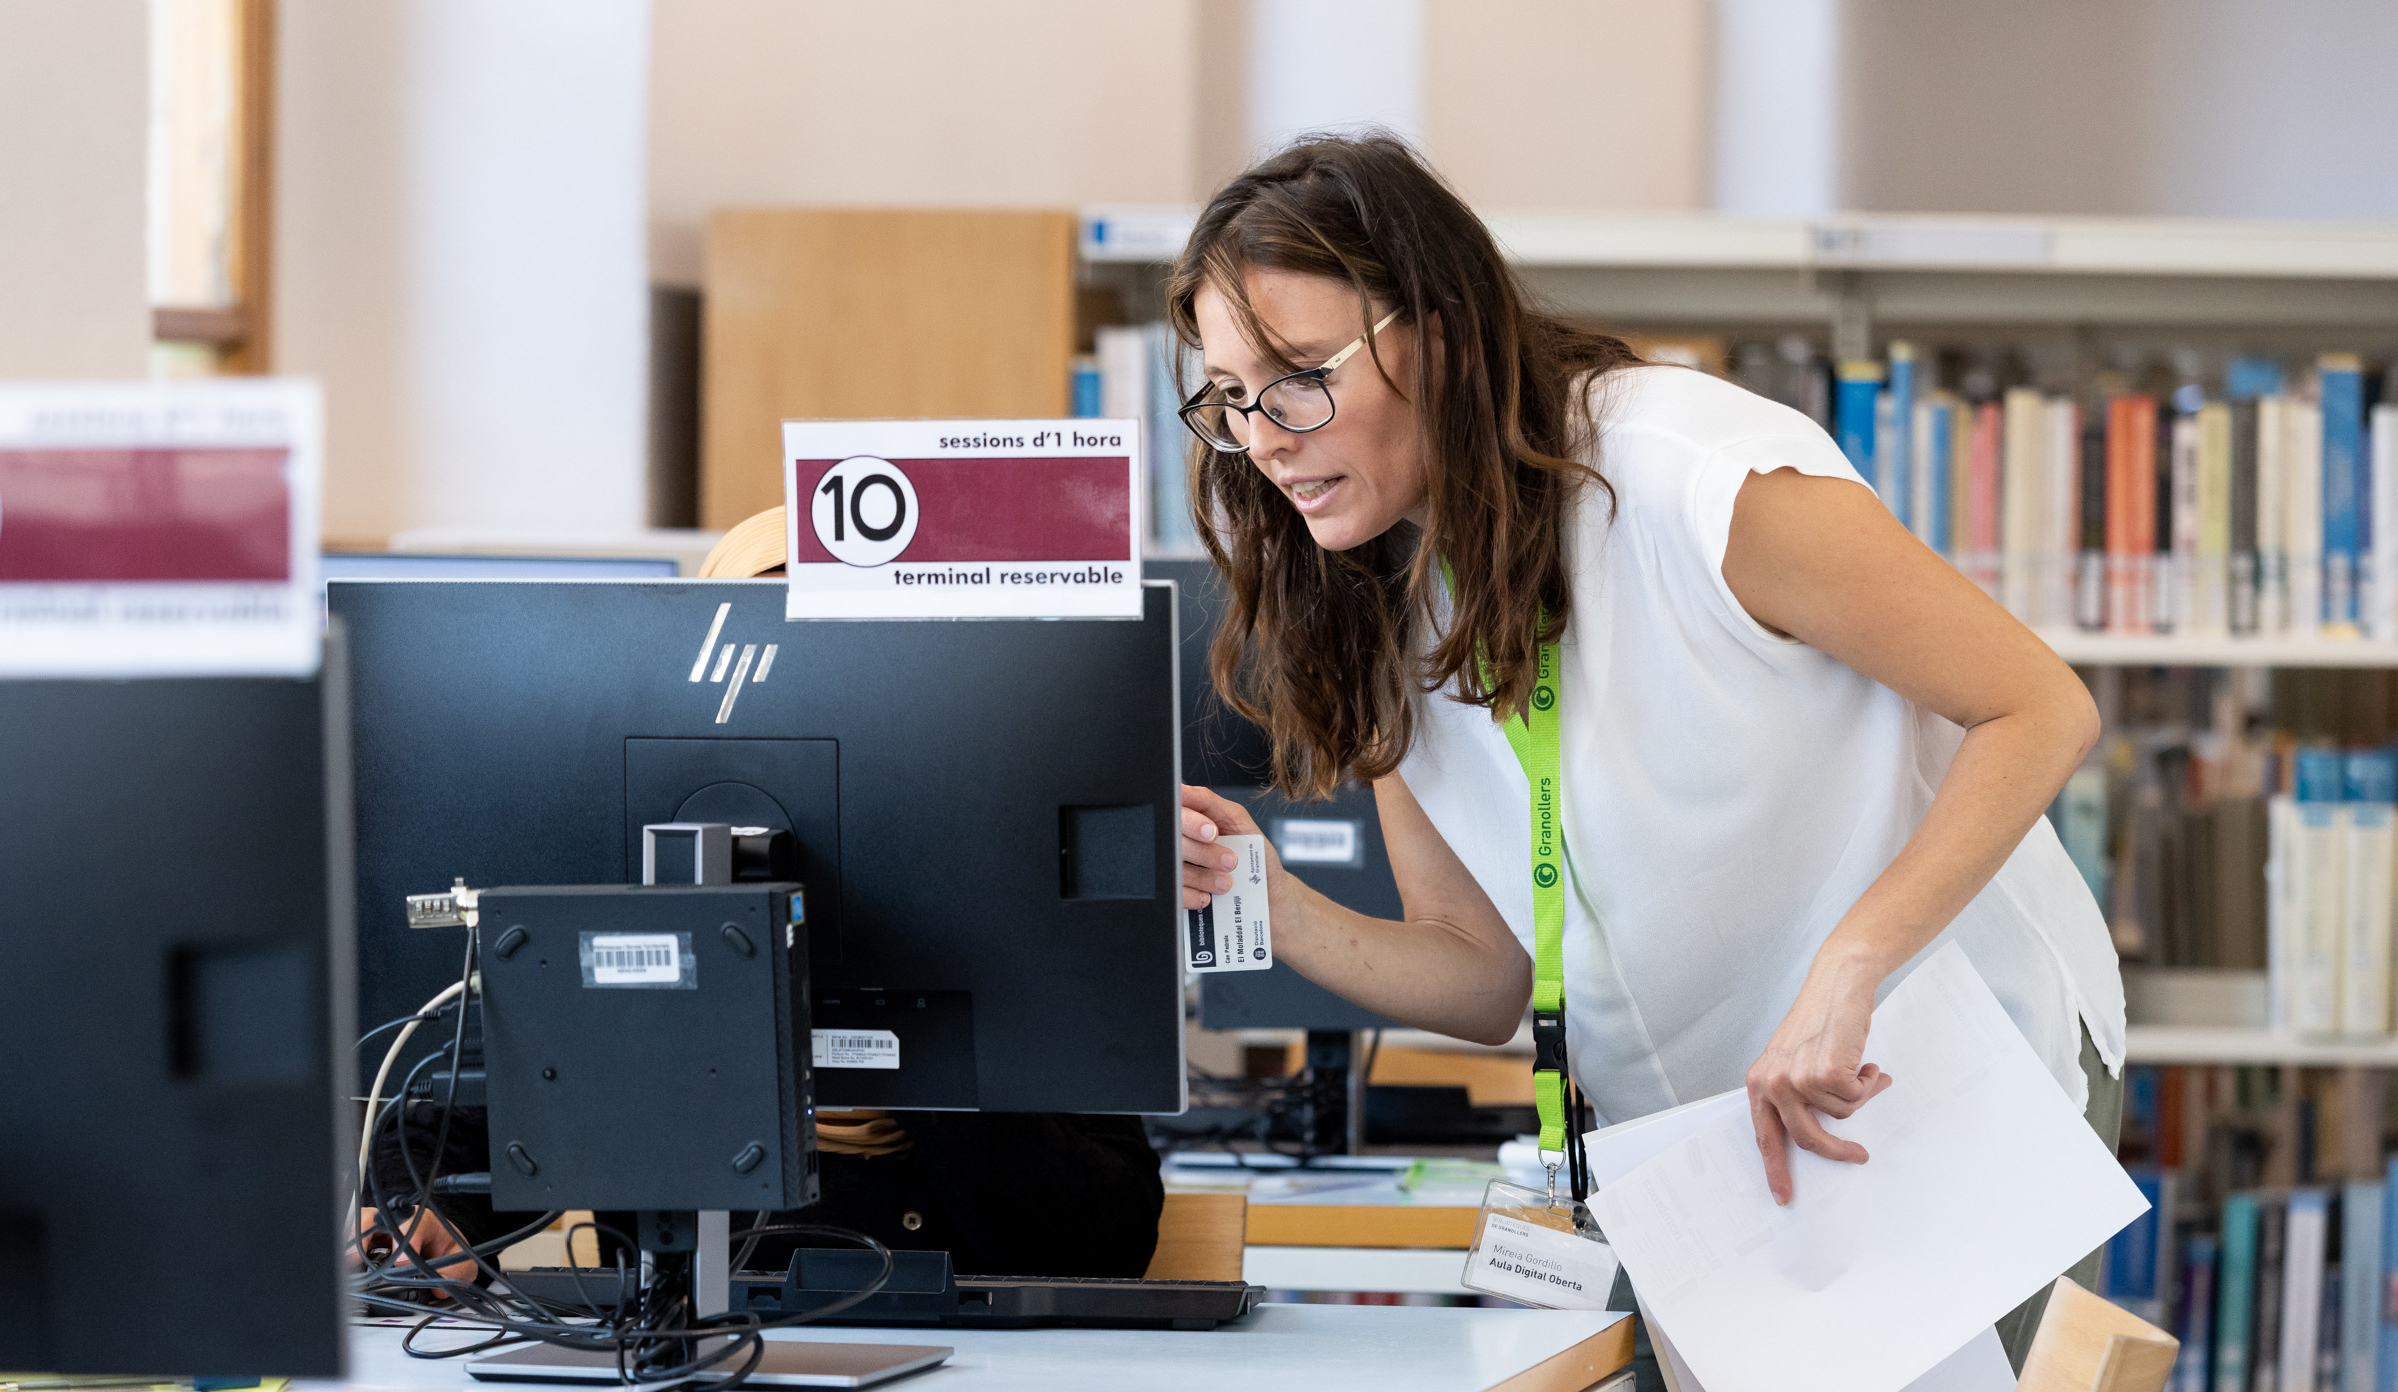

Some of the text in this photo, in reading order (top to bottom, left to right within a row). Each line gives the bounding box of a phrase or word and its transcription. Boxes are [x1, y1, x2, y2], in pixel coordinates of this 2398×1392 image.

[939, 432, 1025, 449] sessions
[1073, 431, 1122, 448] hora
[820, 474, 906, 542] 10
[894, 566, 1123, 585] terminal reservable
[688, 603, 778, 723] hp
[1538, 777, 1551, 857] Granollers
[1489, 1257, 1582, 1291] Aula Digital Oberta
[1493, 1244, 1563, 1272] Mireia Gordillo
